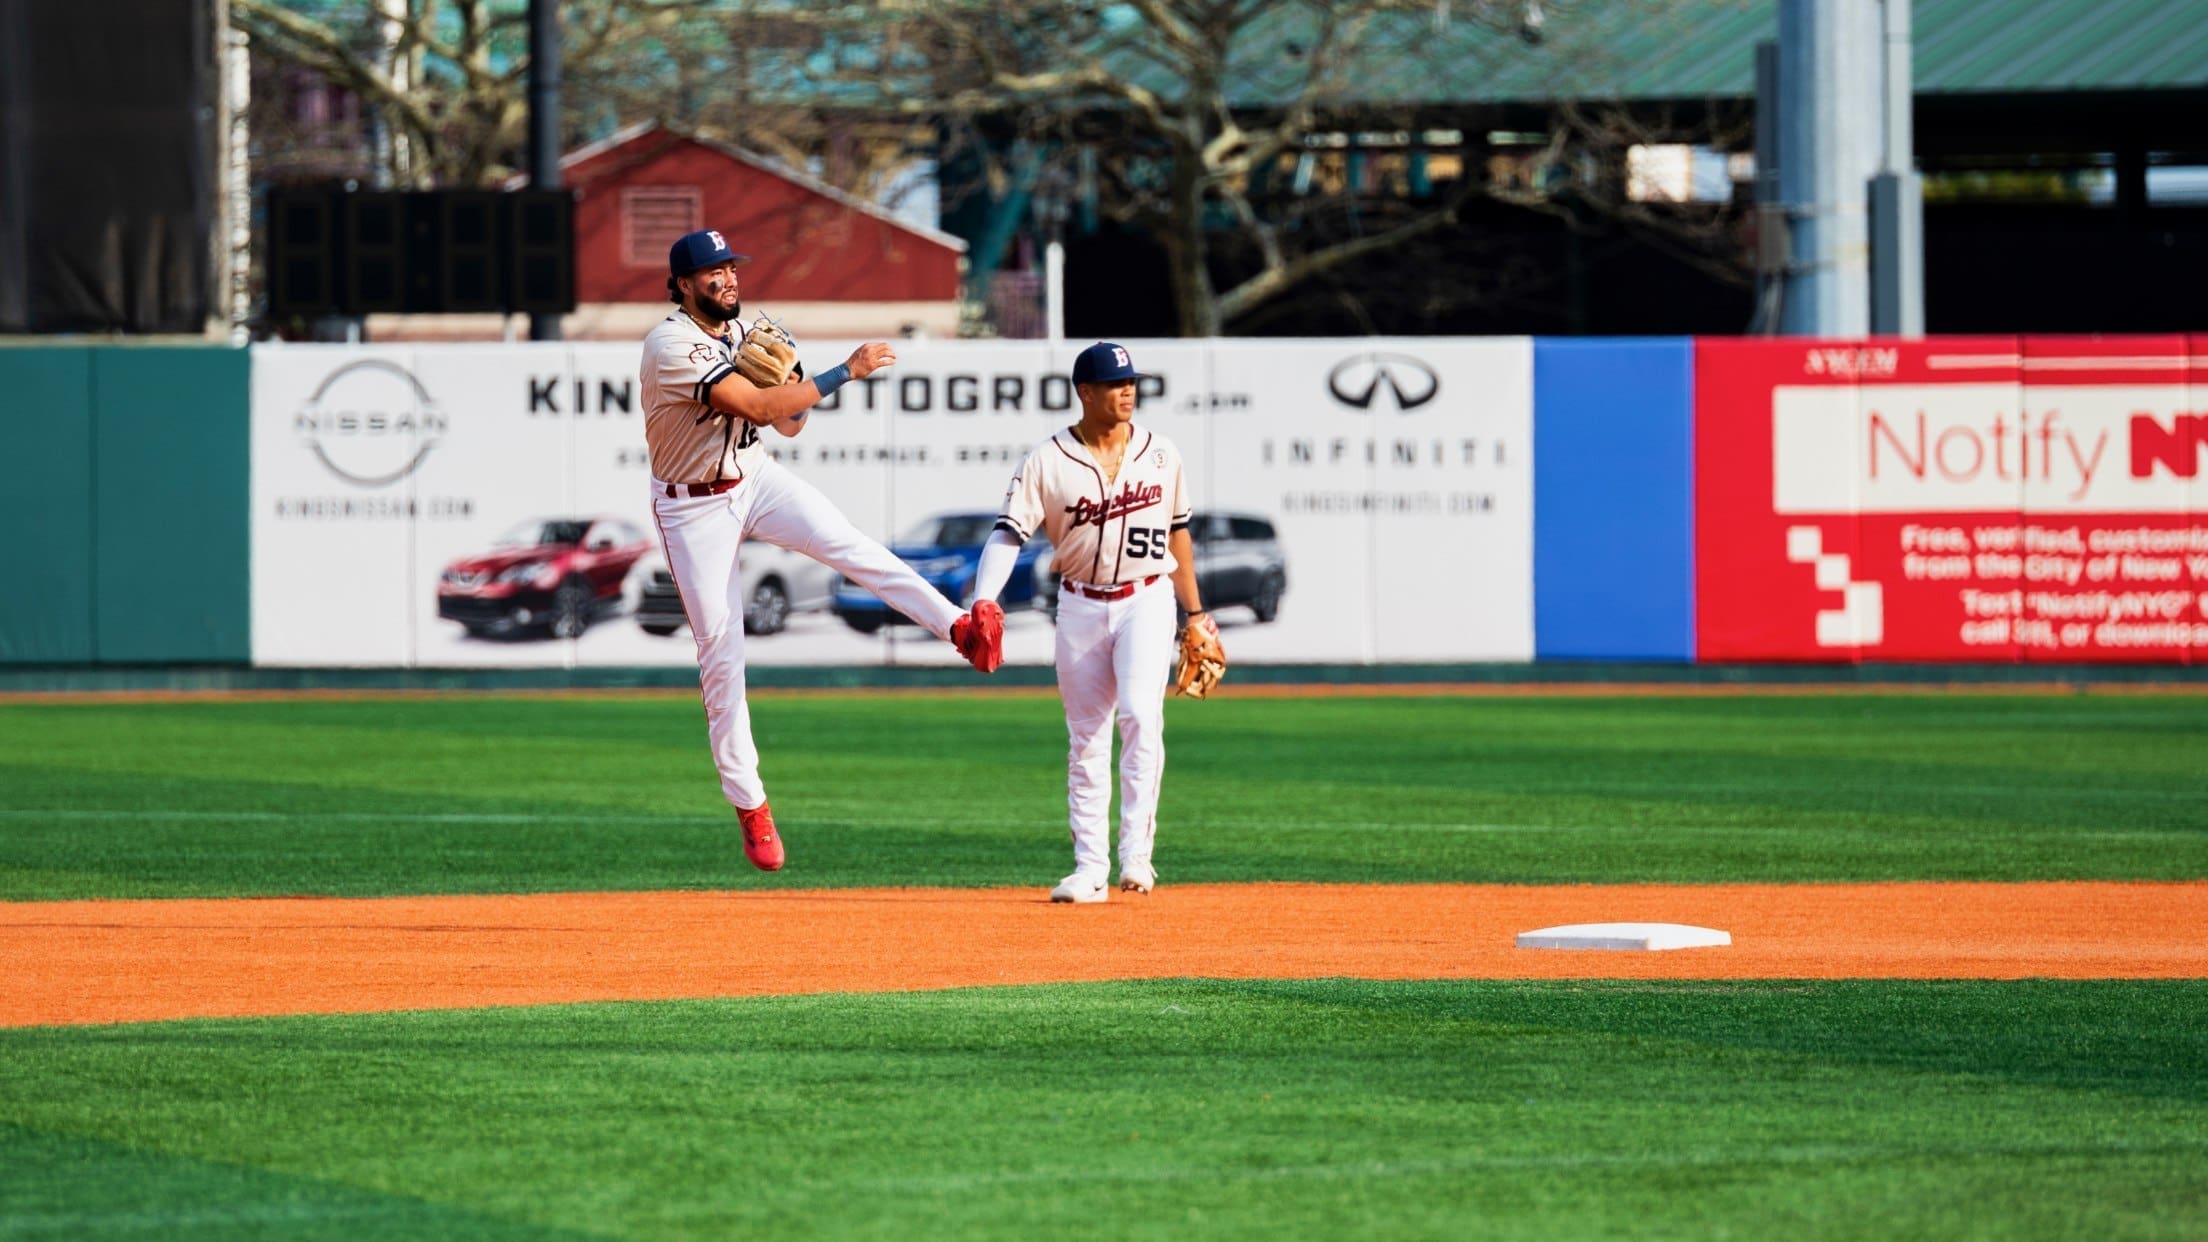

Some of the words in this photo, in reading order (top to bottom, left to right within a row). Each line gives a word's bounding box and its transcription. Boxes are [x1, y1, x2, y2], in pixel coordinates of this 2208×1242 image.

[292, 410, 448, 433] NISSAN
[1261, 438, 1506, 466] INFINITI
[1866, 410, 2108, 502] Notify
[2129, 413, 2208, 479] N
[1126, 527, 1166, 559] 55
[1901, 525, 1970, 552] Free,
[1904, 552, 1971, 580] from
[1974, 553, 2023, 579] the
[2025, 555, 2084, 586] City
[2087, 554, 2118, 581] of
[2121, 555, 2181, 580] New
[1960, 589, 2023, 616] Text
[1960, 617, 2011, 645] call
[2060, 622, 2091, 646] or
